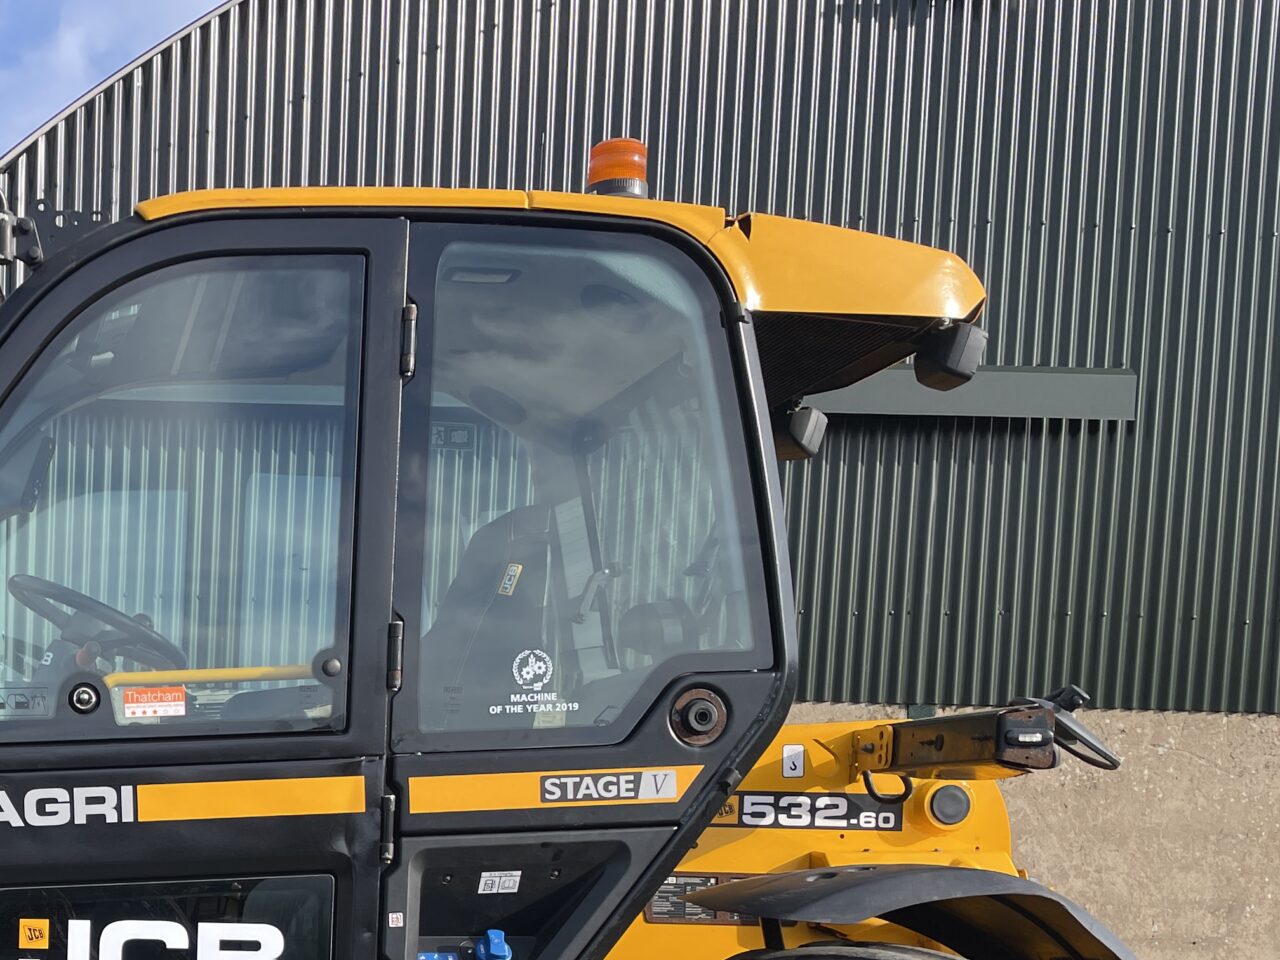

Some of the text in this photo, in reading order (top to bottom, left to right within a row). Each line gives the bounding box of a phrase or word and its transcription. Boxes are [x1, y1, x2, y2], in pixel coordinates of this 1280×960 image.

[126, 691, 182, 703] Thatcham
[510, 692, 557, 703] MACHINE
[489, 702, 579, 715] OF THE YEAR 2019
[544, 773, 670, 800] STAGE V
[27, 926, 45, 942] JCB
